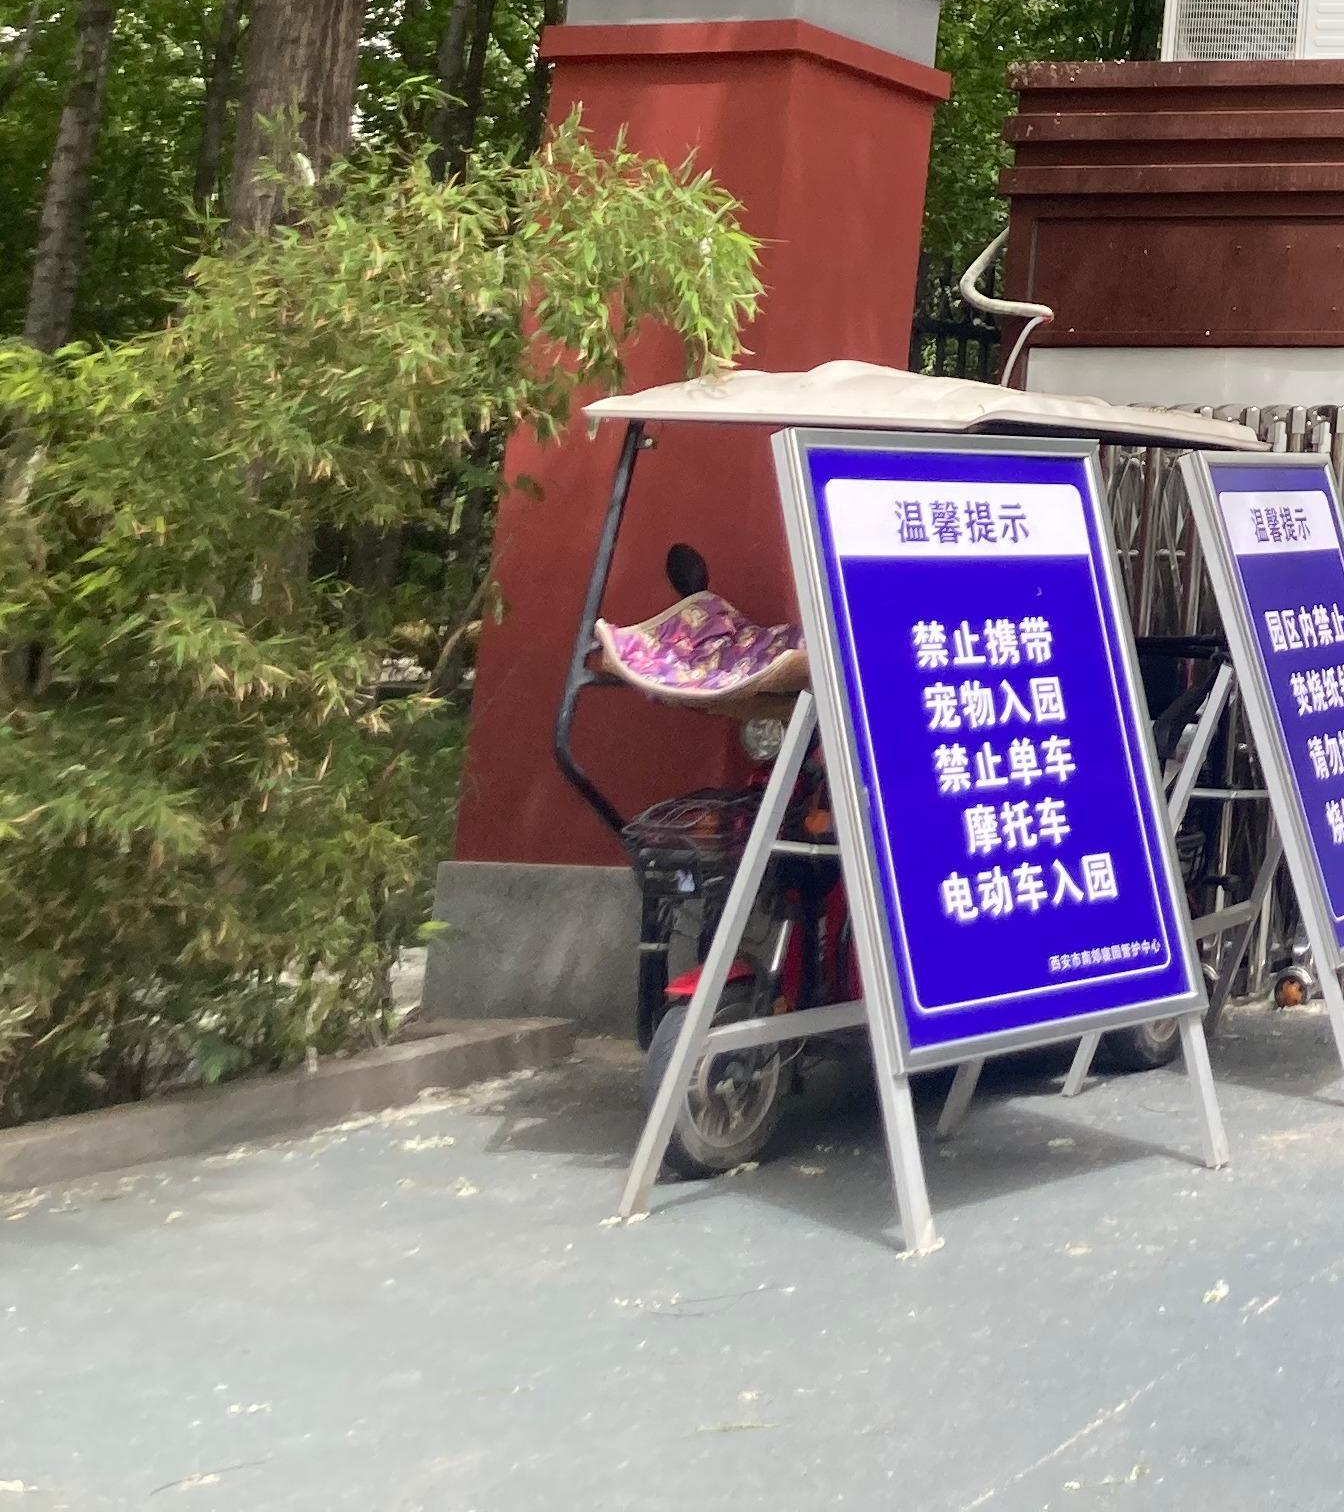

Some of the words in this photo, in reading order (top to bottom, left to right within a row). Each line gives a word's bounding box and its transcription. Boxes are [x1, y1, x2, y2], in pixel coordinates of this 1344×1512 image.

[894, 500, 1031, 545] 温馨提示
[1249, 505, 1312, 544] 温馨提示
[911, 616, 1054, 670] 禁止携带
[923, 675, 1067, 733] 宠物入园
[932, 734, 1077, 795] 禁止单车
[962, 796, 1073, 859] 摩托车
[939, 851, 1120, 924] 电动车入园
